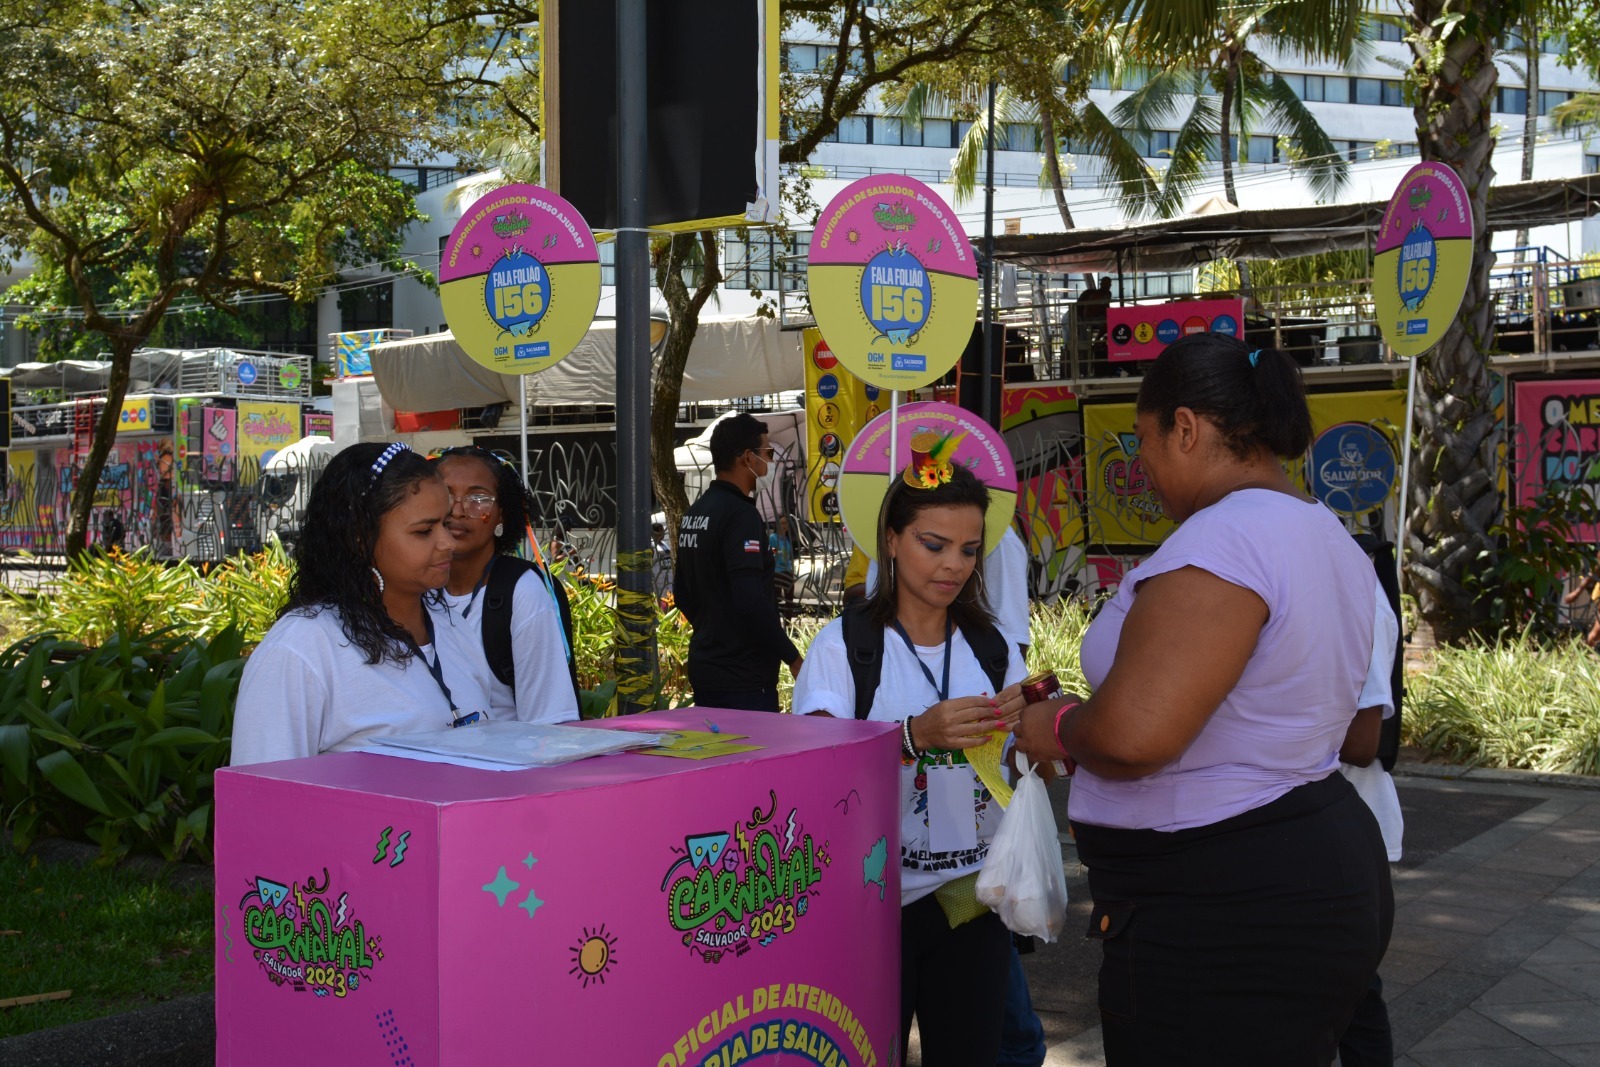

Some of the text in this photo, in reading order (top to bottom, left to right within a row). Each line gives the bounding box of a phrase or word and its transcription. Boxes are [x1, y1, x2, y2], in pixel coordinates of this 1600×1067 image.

[449, 219, 477, 268] OUVIDORIA
[475, 211, 487, 221] DE
[530, 197, 558, 215] POSSO
[556, 212, 585, 249] AJUDAR?
[820, 198, 855, 249] OUVIDORIA
[854, 192, 867, 203] DE
[916, 193, 943, 219] POSSO
[941, 217, 966, 262] AJUDAR?
[493, 265, 541, 288] FALA FOLIÃO
[871, 266, 923, 288] FALA FOLIÃO
[1400, 258, 1431, 293] 156
[494, 283, 543, 320] 156
[871, 284, 924, 323] 156
[494, 345, 509, 356] OGM
[525, 345, 547, 353] SALVADOR
[867, 352, 884, 362] OGM
[1545, 399, 1564, 426] O
[856, 422, 891, 461] OUVIDORI
[957, 418, 985, 441] POSSO
[982, 439, 1006, 477] AJUDAR?
[1545, 427, 1600, 452] CAR
[1323, 470, 1382, 482] SALVADOR
[1546, 455, 1581, 481] DO
[1131, 497, 1164, 514] SALVA
[668, 829, 822, 932] CARNAVAL
[923, 858, 958, 871] MUNDO
[244, 897, 374, 970] CARNAVAL
[696, 901, 796, 947] SALVADOR 2023
[263, 952, 347, 998] SALVADOR 2023
[657, 983, 878, 1067] OFICIAL DE ATENDIMENT
[703, 1023, 848, 1067] RIA DE SALVA
